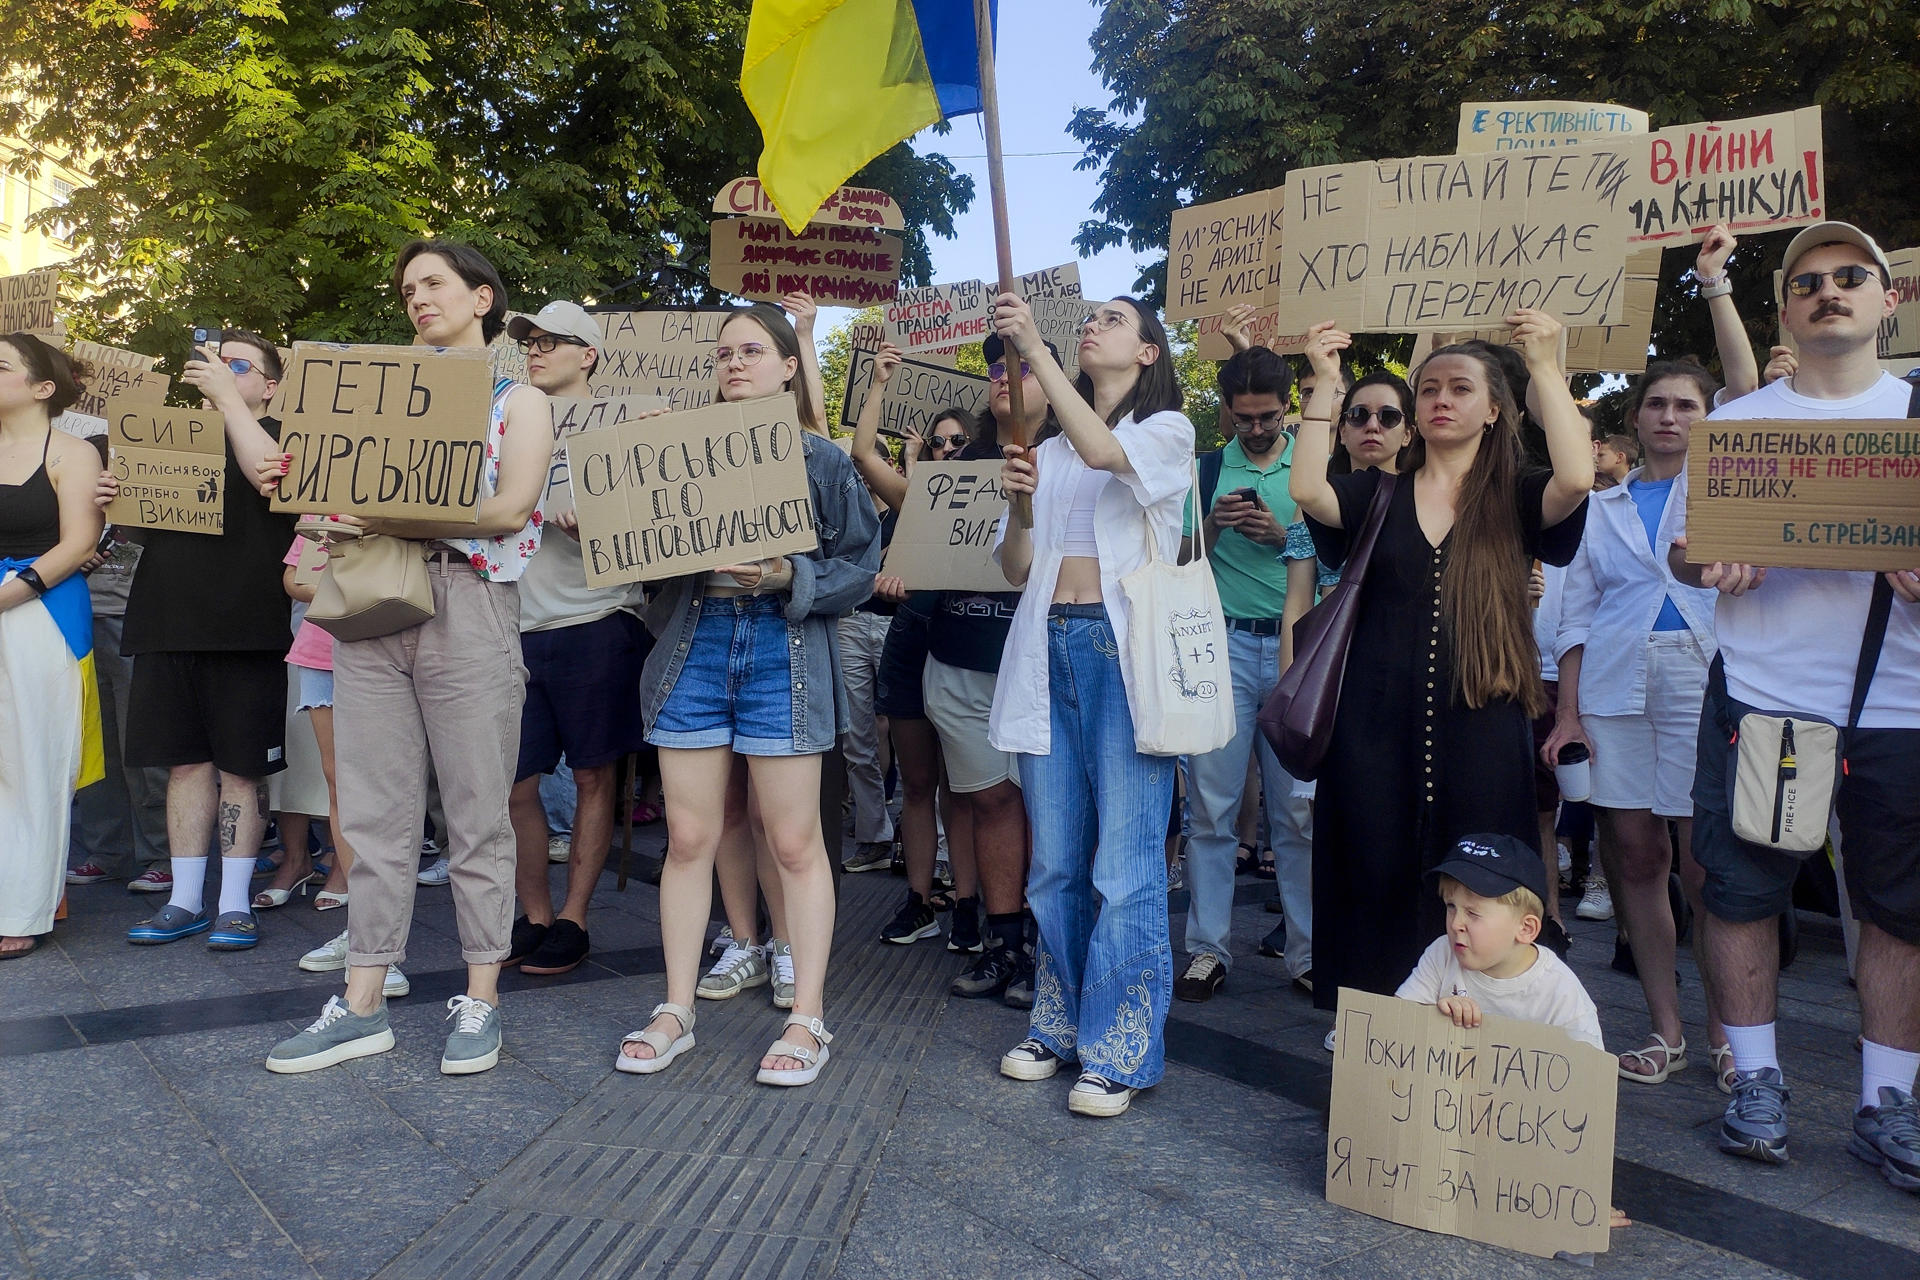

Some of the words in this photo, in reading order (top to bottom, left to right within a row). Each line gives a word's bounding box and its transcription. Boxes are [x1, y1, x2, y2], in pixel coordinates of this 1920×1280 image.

[1650, 126, 1773, 185] ВІЙНИ
[1302, 173, 1343, 221] НЕ
[1180, 254, 1194, 280] В
[1208, 237, 1264, 273] АРМІЇ
[1299, 243, 1369, 296] ХТО
[1384, 223, 1600, 276] НАБЛИЖАЄ
[7, 273, 50, 302] ГОЛОВУ
[950, 280, 981, 300] МЕНІ
[1022, 267, 1063, 295] МАЄ
[1180, 278, 1209, 307] НЕ
[1386, 266, 1625, 327] ПЕРЕМОГУ!
[959, 294, 979, 312] ЩО
[897, 312, 951, 336] ПРАЦЮЄ
[593, 347, 714, 382] УЖЖАЩАЯ
[98, 381, 122, 399] ЦЕ
[294, 359, 432, 418] ГЕТЬ
[120, 413, 204, 445] СИР
[1708, 432, 1836, 456] МАЛЕНЬКА
[277, 431, 485, 508] СИРСЬКОГО
[583, 421, 793, 497] СИРСЬКОГО
[1708, 456, 1778, 478] АРМІЯ
[1790, 457, 1817, 479] НЕ
[650, 481, 704, 526] ДО
[1707, 478, 1797, 499] ВЕЛИКУ.
[589, 498, 815, 576] ВІДПОВІДАЛЬНОСТІ
[1783, 522, 1802, 545] Б.
[1491, 1044, 1571, 1093] ТАТО
[1433, 1088, 1588, 1154] ВІЙСЬКУ
[1331, 1136, 1352, 1187] Я
[1428, 1169, 1479, 1210] ЗА
